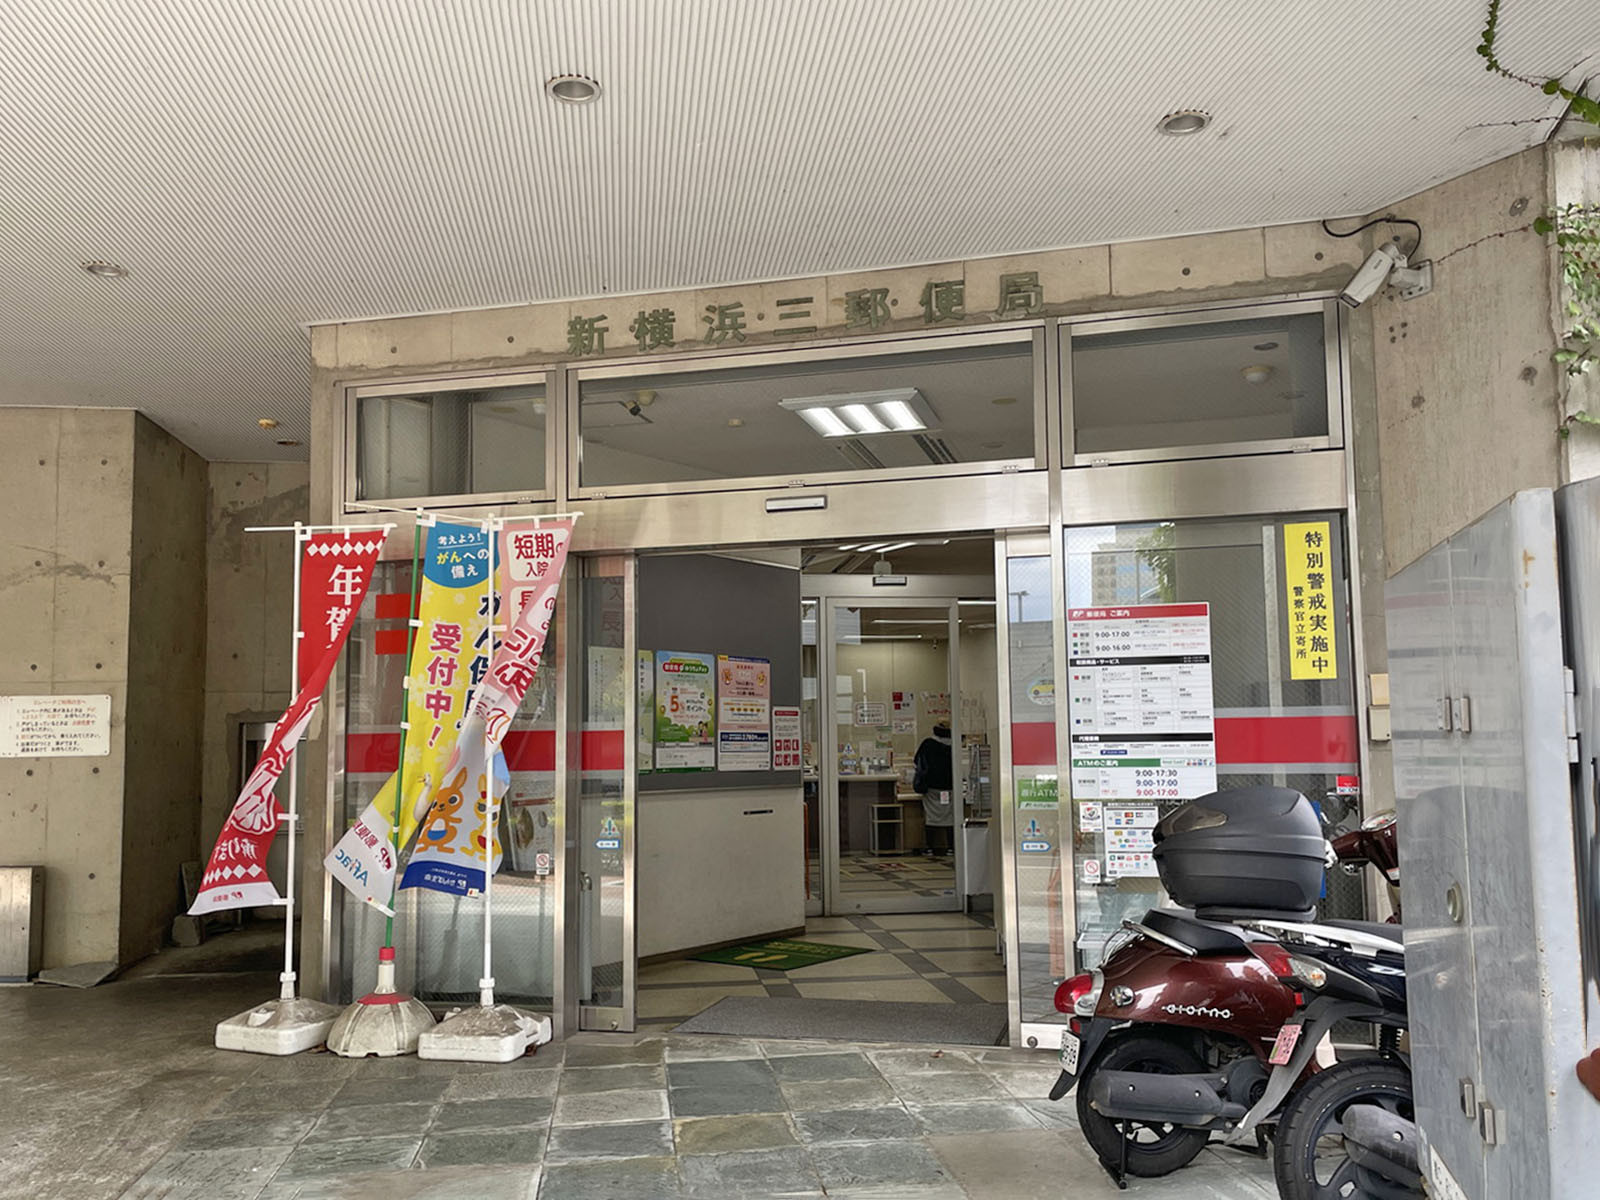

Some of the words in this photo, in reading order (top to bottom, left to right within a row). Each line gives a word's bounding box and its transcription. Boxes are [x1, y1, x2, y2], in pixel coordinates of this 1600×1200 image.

[567, 271, 1044, 357] 新横浜三郵便局
[437, 532, 483, 546] 考えよう!
[436, 548, 490, 565] がんへの
[451, 562, 479, 580] 備え
[1304, 530, 1329, 674] 特別警戒実施中
[1292, 586, 1307, 660] 警察官立寄所
[425, 623, 462, 747] 受付中!
[670, 696, 679, 712] 5
[1135, 769, 1178, 778] 9:00-17:30
[1135, 779, 1179, 788] 9:00-17:00
[1136, 788, 1179, 797] 9:00-17:00
